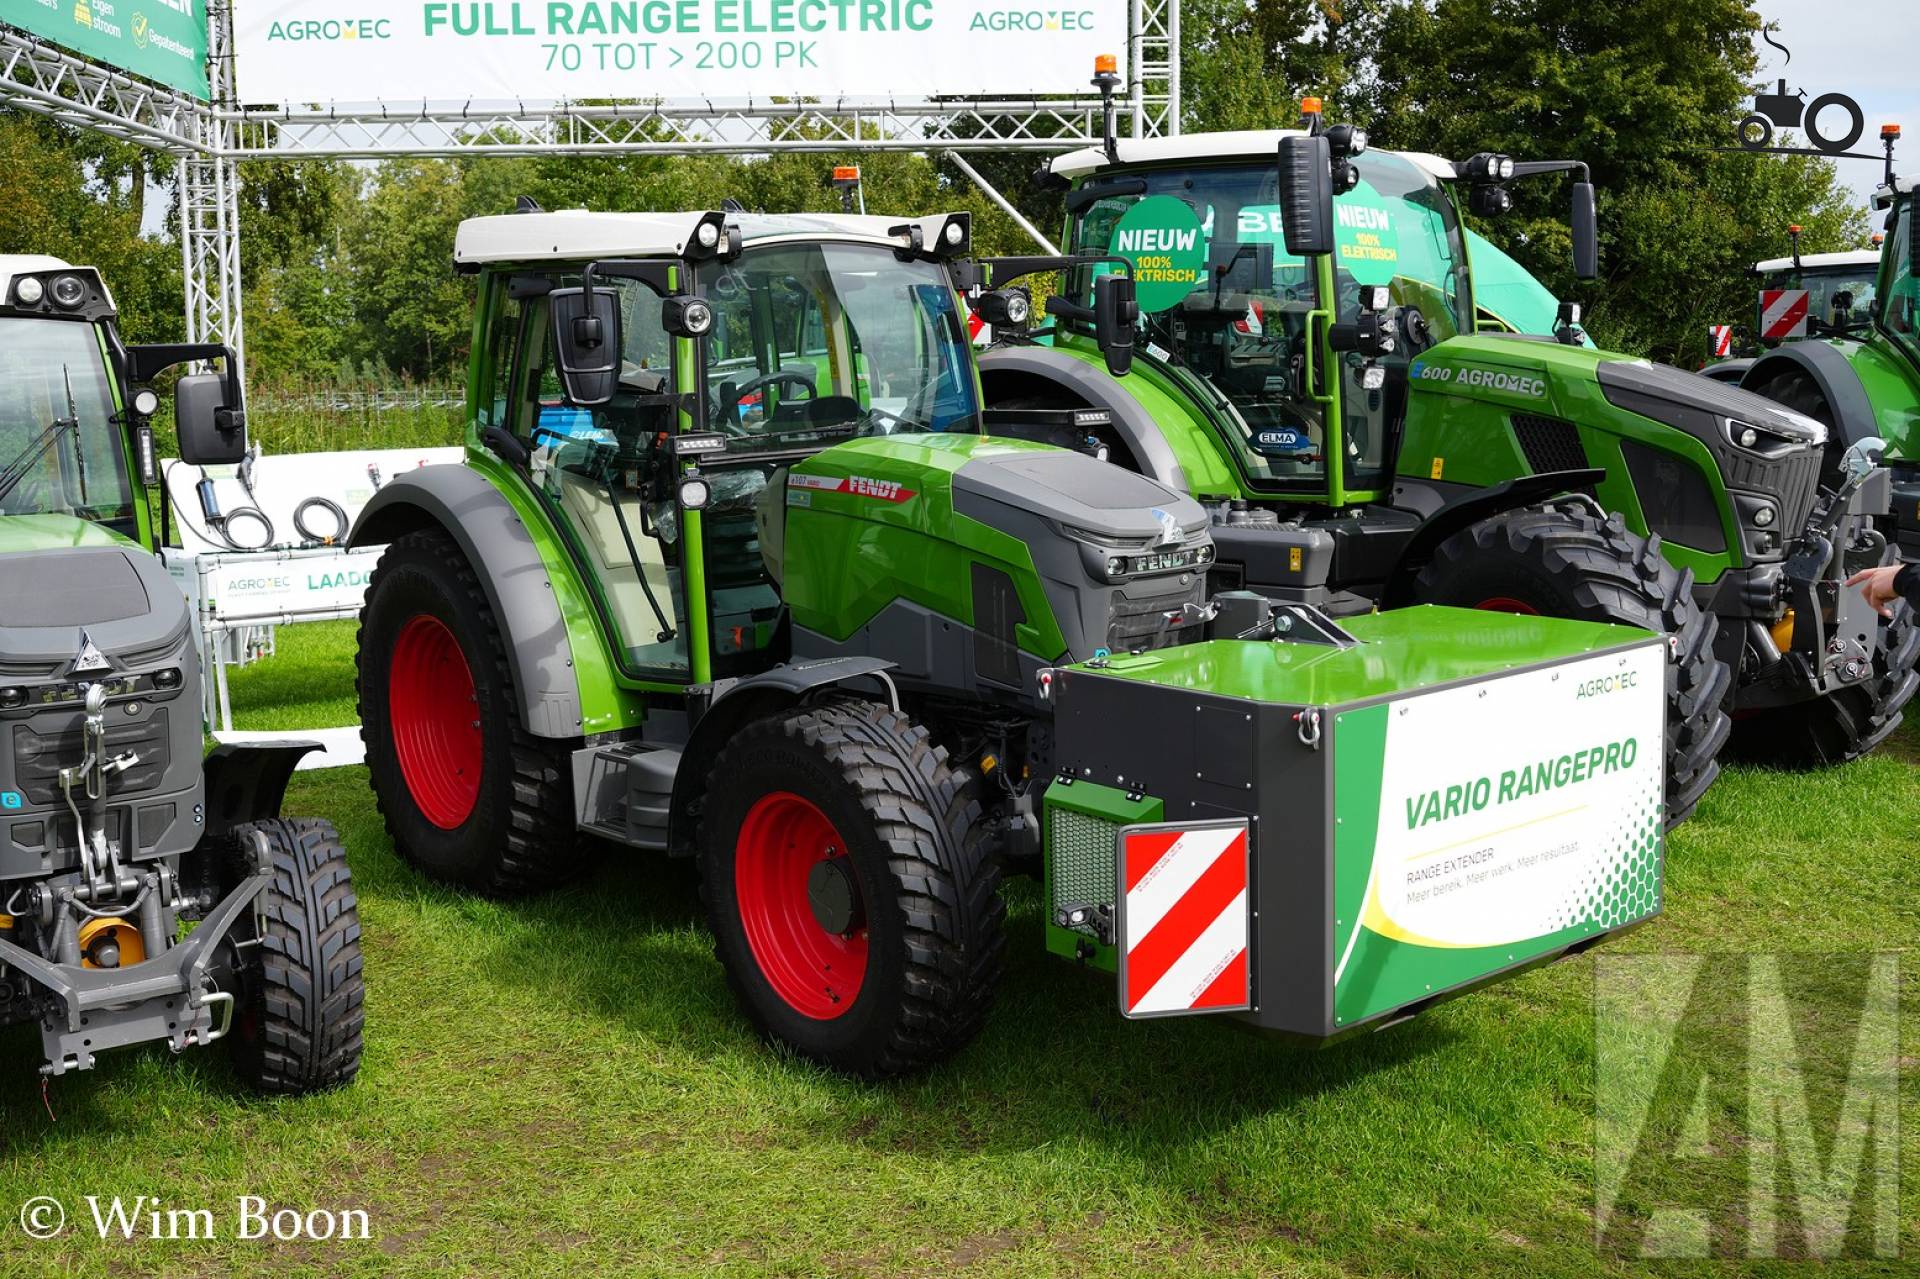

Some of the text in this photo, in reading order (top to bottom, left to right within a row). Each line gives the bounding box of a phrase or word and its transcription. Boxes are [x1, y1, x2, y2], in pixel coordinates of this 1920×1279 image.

[93, 16, 121, 38] stroom
[424, 0, 933, 36] FULL RANGE ELECTRIC
[541, 40, 818, 71] 70 TOT > 200 PK
[1335, 204, 1390, 231] NIEUW
[1118, 228, 1197, 252] NIEUW
[1341, 243, 1397, 261] ELEKTRISCH
[1136, 255, 1172, 269] 100%
[1410, 361, 1545, 396] E600 AGROMEC
[1261, 432, 1294, 443] ELMA
[849, 475, 902, 499] FENDT
[1135, 551, 1194, 573] FENDT
[1406, 738, 1637, 830] VARIO RANGEPRO
[1407, 847, 1494, 885] RANGE EXTENDER
[1407, 889, 1430, 904] Meer
[1466, 870, 1488, 887] Meer
